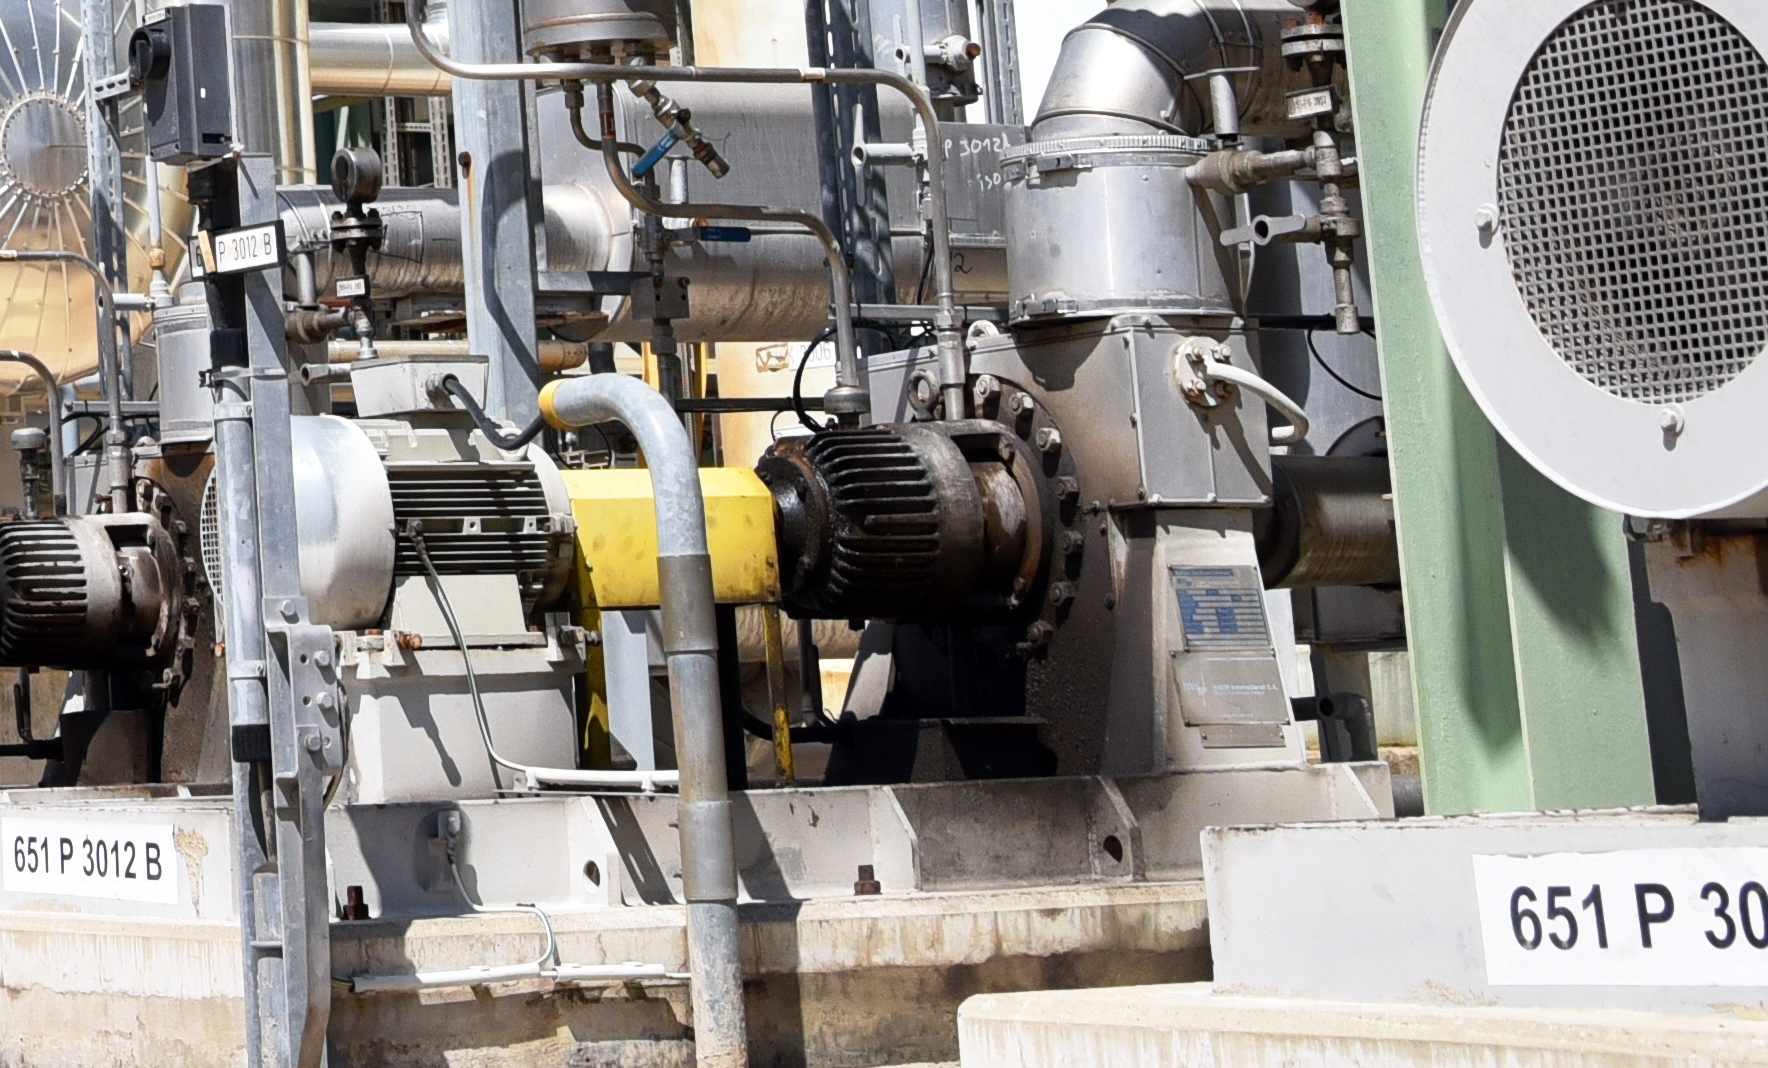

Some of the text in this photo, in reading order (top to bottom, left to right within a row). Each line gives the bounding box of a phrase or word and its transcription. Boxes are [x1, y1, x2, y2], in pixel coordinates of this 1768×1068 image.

[218, 241, 226, 264] P
[232, 234, 258, 261] 3012
[263, 232, 272, 255] B
[14, 835, 163, 881] 651 P 3012 B
[1510, 881, 1768, 951] 651 P 30
